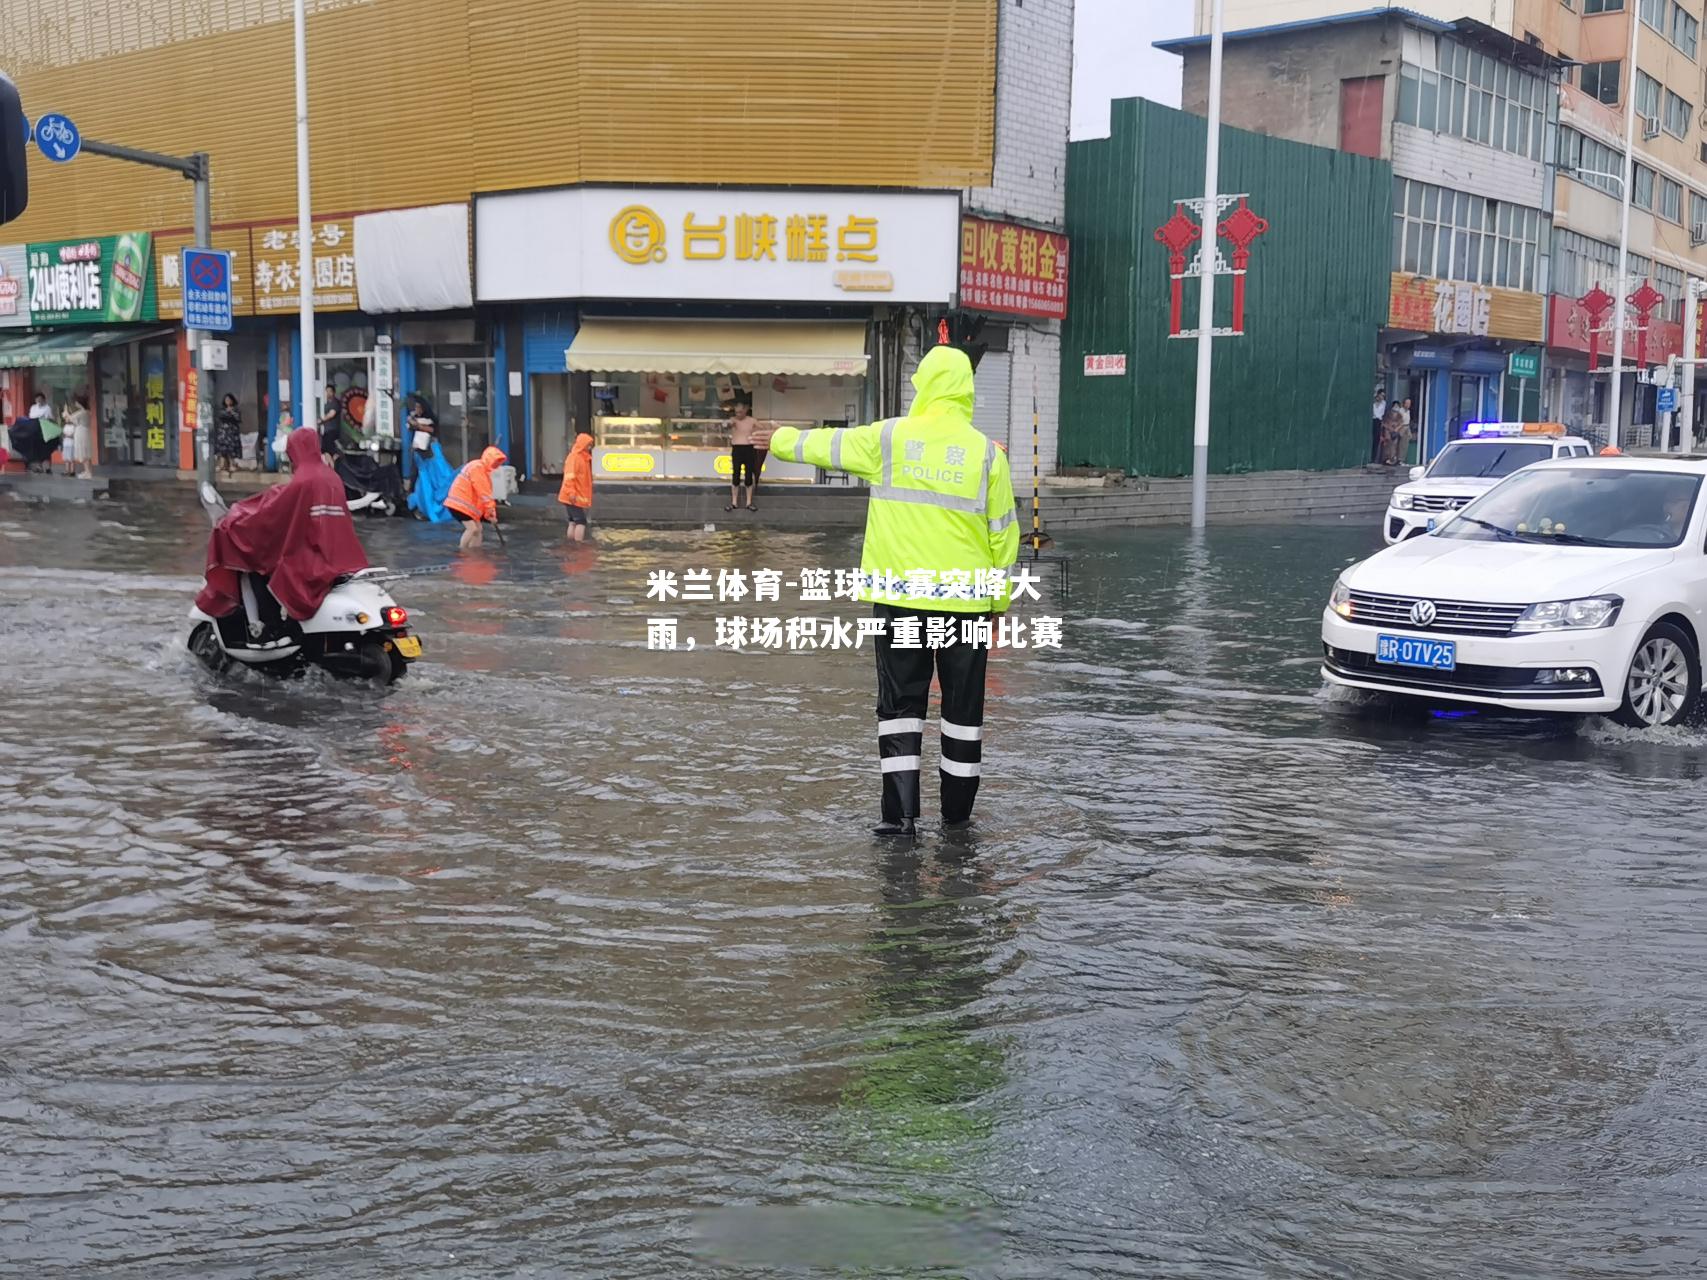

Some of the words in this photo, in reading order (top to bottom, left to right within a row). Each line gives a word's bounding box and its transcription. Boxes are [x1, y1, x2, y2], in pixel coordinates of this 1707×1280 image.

[683, 211, 879, 263] 台峡糕点
[961, 221, 1057, 280] 回收黄铂金
[29, 260, 102, 312] 24H便利店
[255, 253, 355, 294] 寿衣圈店
[1087, 355, 1125, 370] 黄金回收
[145, 372, 165, 450] 便利店
[902, 464, 965, 484] POLICE
[904, 439, 966, 467] 警察
